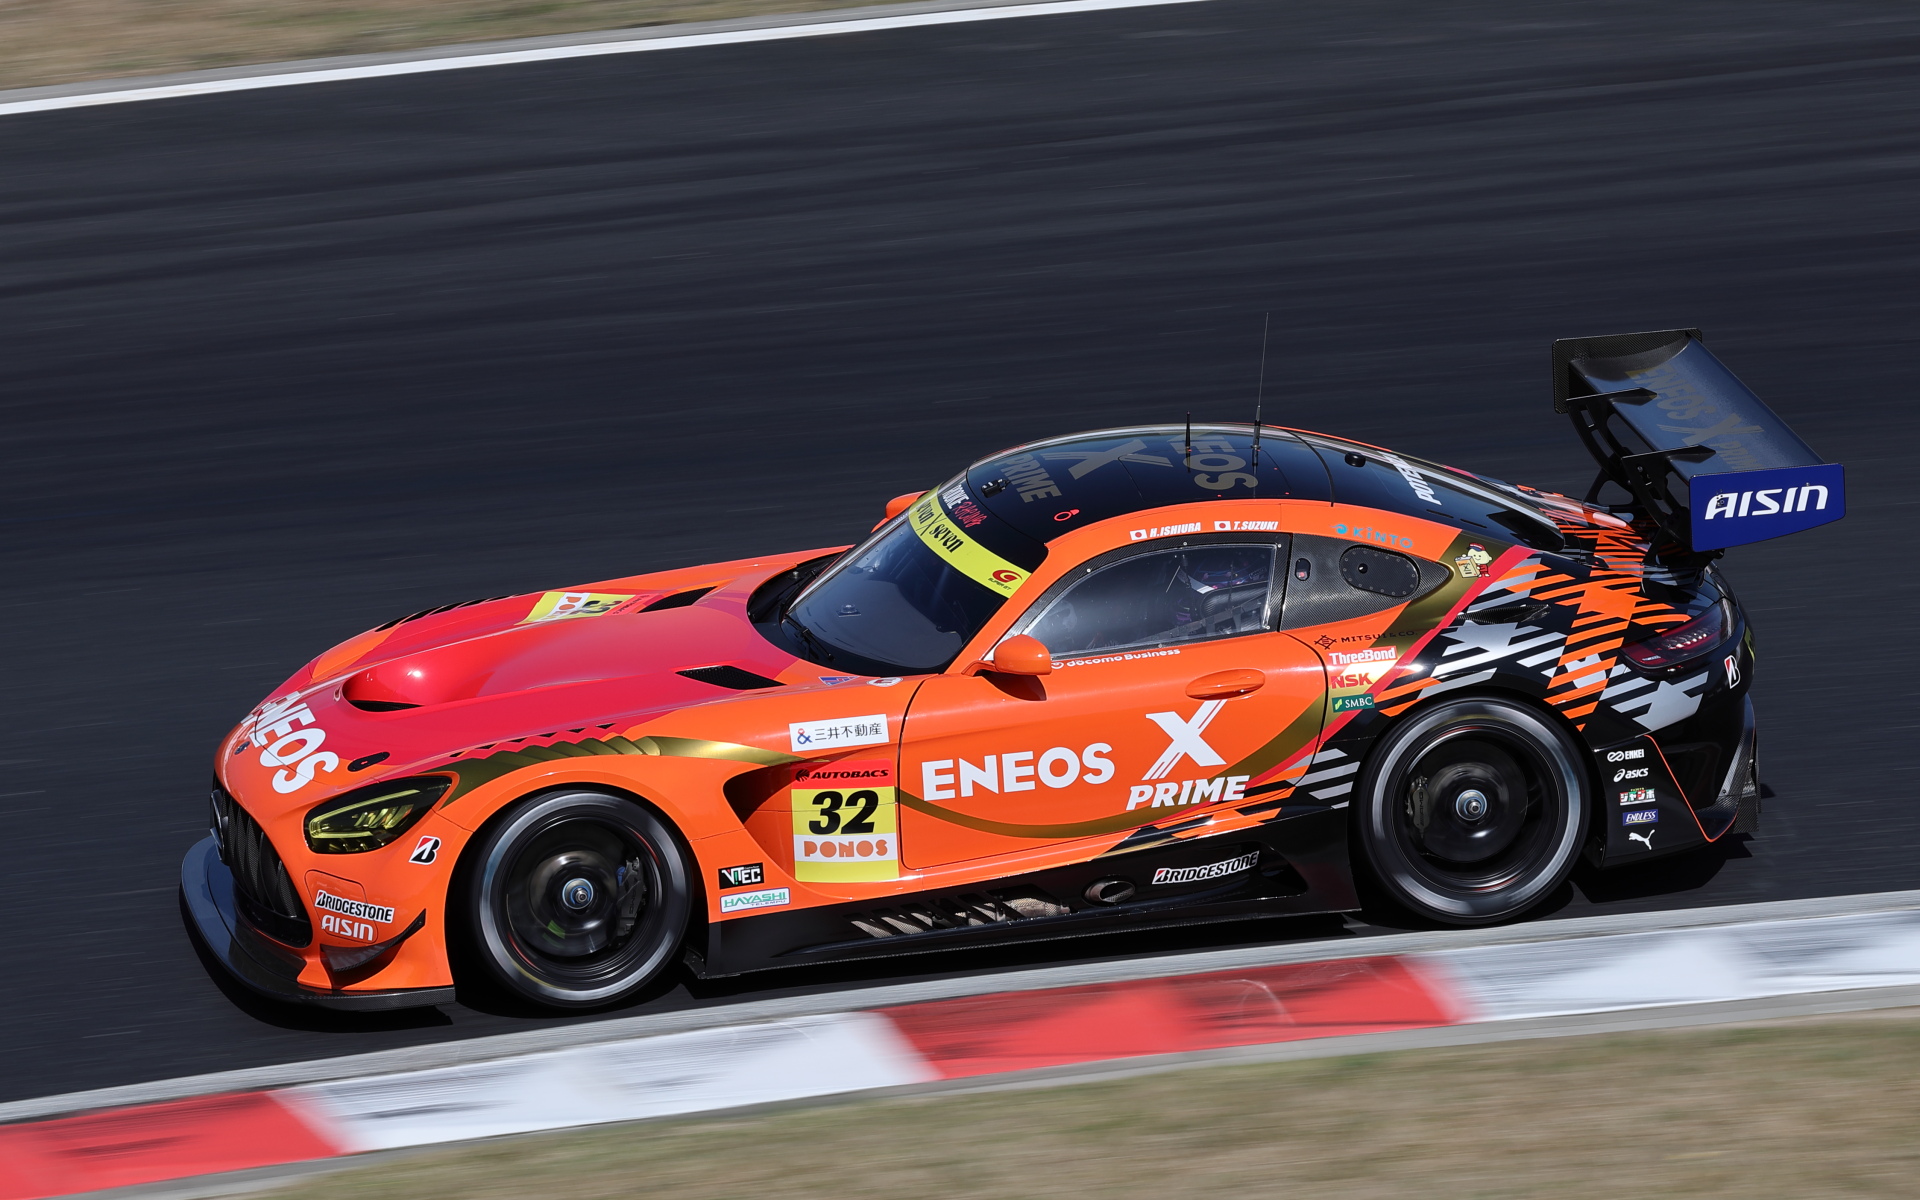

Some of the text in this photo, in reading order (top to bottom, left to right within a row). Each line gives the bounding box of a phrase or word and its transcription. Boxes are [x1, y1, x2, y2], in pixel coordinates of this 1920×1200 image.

[1167, 432, 1259, 490] EOS
[994, 453, 1063, 503] PRIME
[1377, 451, 1442, 505] POTE
[1704, 485, 1829, 519] AISIN
[915, 501, 935, 524] even
[929, 523, 964, 553] seven
[1150, 522, 1201, 538] H.ISHIURA
[1233, 521, 1278, 531] T.SUZUKI
[1124, 648, 1180, 661] Business
[1329, 647, 1397, 665] ThreeBond
[1331, 672, 1374, 689] NSK
[1345, 697, 1373, 708] SMBC
[814, 722, 883, 741] 三井不動産
[1142, 700, 1227, 780] X
[1624, 748, 1645, 760] ENKEI
[810, 769, 890, 780] AUTOBACS
[922, 743, 1115, 801] ENEOS
[1625, 767, 1649, 779] asics
[1125, 775, 1251, 811] PRIME
[807, 789, 879, 835] 32
[1626, 811, 1657, 823] ENDLESS
[803, 840, 888, 859] PONOS
[1151, 851, 1260, 884] BRIDGESTONE
[315, 889, 395, 924] BRIDGESTONE
[724, 892, 788, 909] HAYASHI
[321, 914, 374, 941] AISIN
